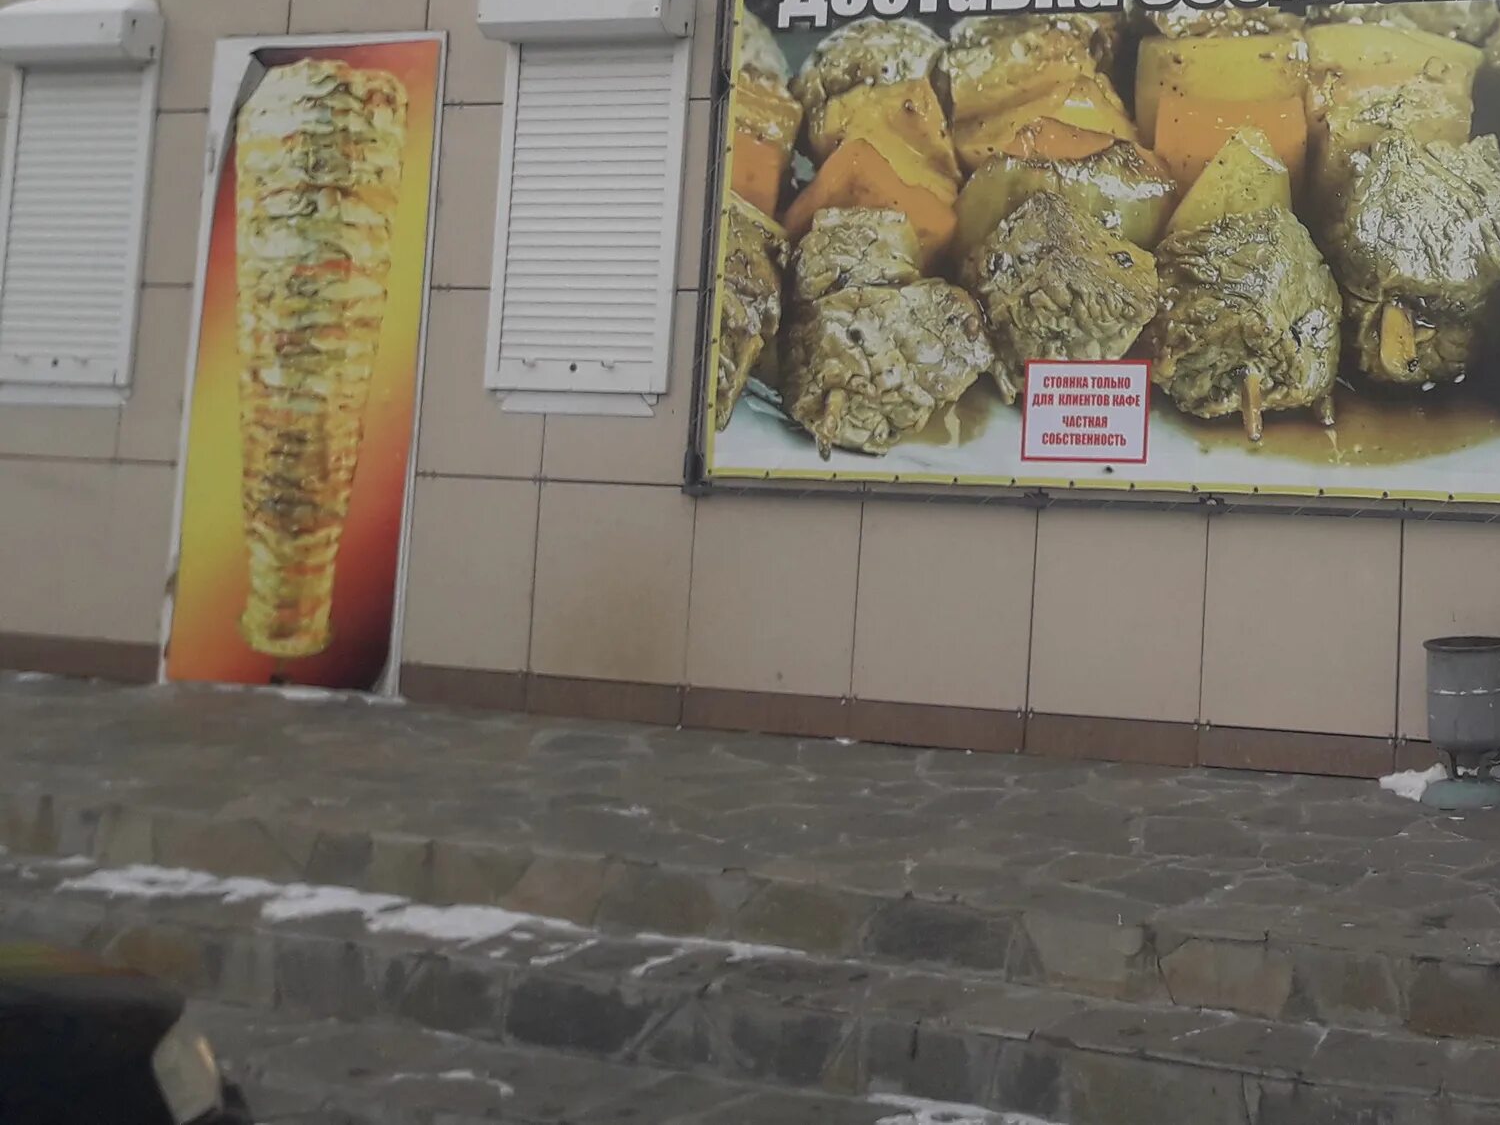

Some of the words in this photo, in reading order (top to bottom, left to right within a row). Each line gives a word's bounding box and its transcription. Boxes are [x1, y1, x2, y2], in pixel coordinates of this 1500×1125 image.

[1043, 376, 1089, 389] СТОЯНКА
[1091, 377, 1131, 389] ТОЛЬКО
[1032, 394, 1054, 407] ДЛЯ
[1058, 394, 1110, 407] КЛИЕНТОВ
[1112, 394, 1141, 407] КАФЕ
[1062, 416, 1108, 428] ЧАСТНАЯ
[1042, 433, 1127, 446] СОБСТВЕННОСТЬ
